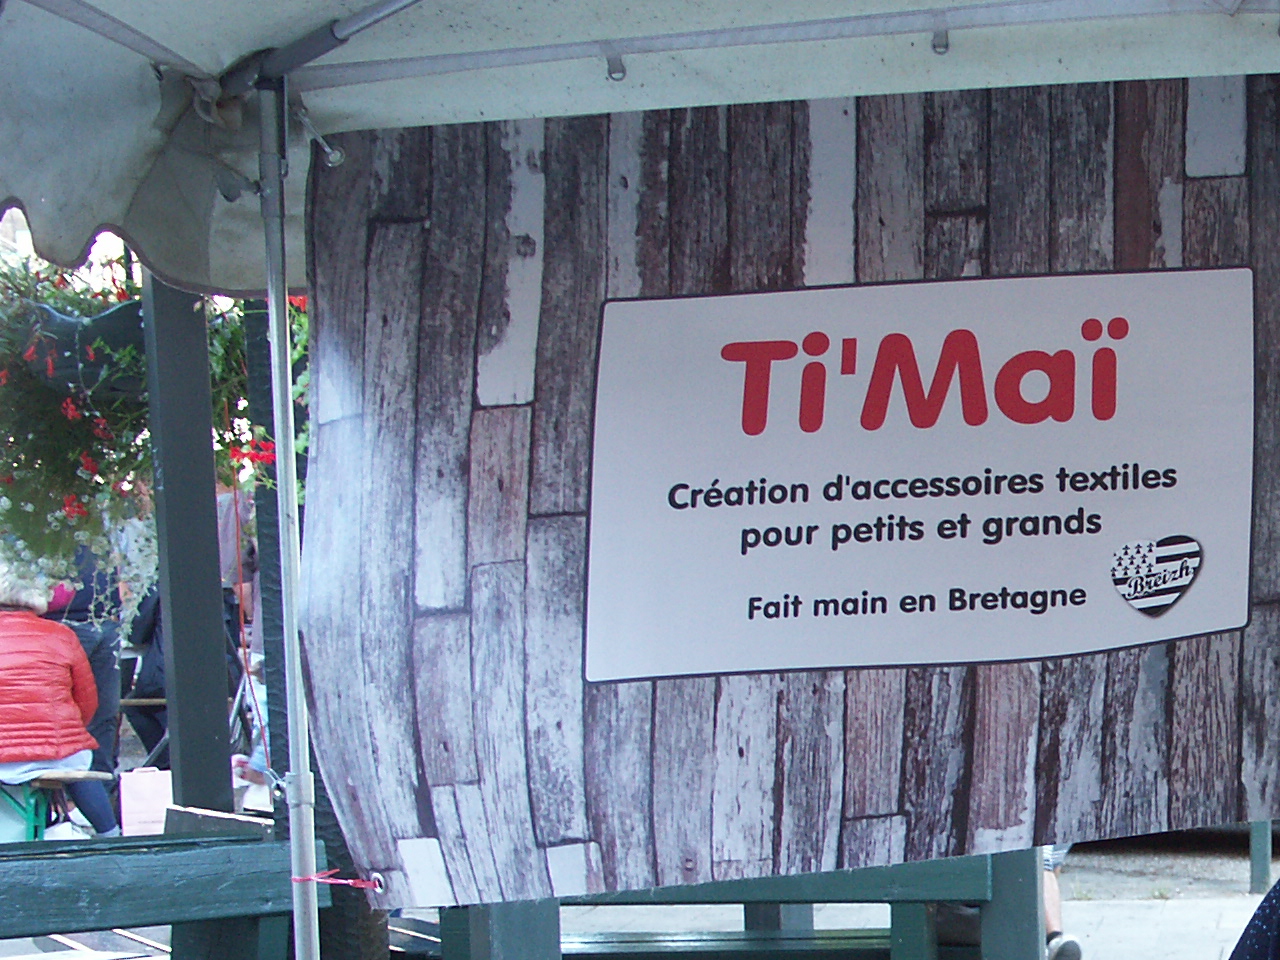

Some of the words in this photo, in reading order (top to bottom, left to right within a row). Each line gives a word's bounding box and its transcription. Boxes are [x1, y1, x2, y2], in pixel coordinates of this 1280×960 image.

[721, 317, 1129, 436] Ti'Maï
[668, 479, 809, 509] Création
[822, 467, 1044, 501] d'accessoires
[1056, 463, 1177, 492] textiles
[741, 524, 819, 556] pour
[831, 514, 924, 551] petits
[937, 513, 971, 539] et
[982, 507, 1102, 545] grands
[1126, 558, 1195, 598] Breizh
[748, 594, 802, 620] Fait
[813, 590, 887, 616] main
[899, 594, 936, 613] en
[949, 587, 1087, 615] Bretagne
